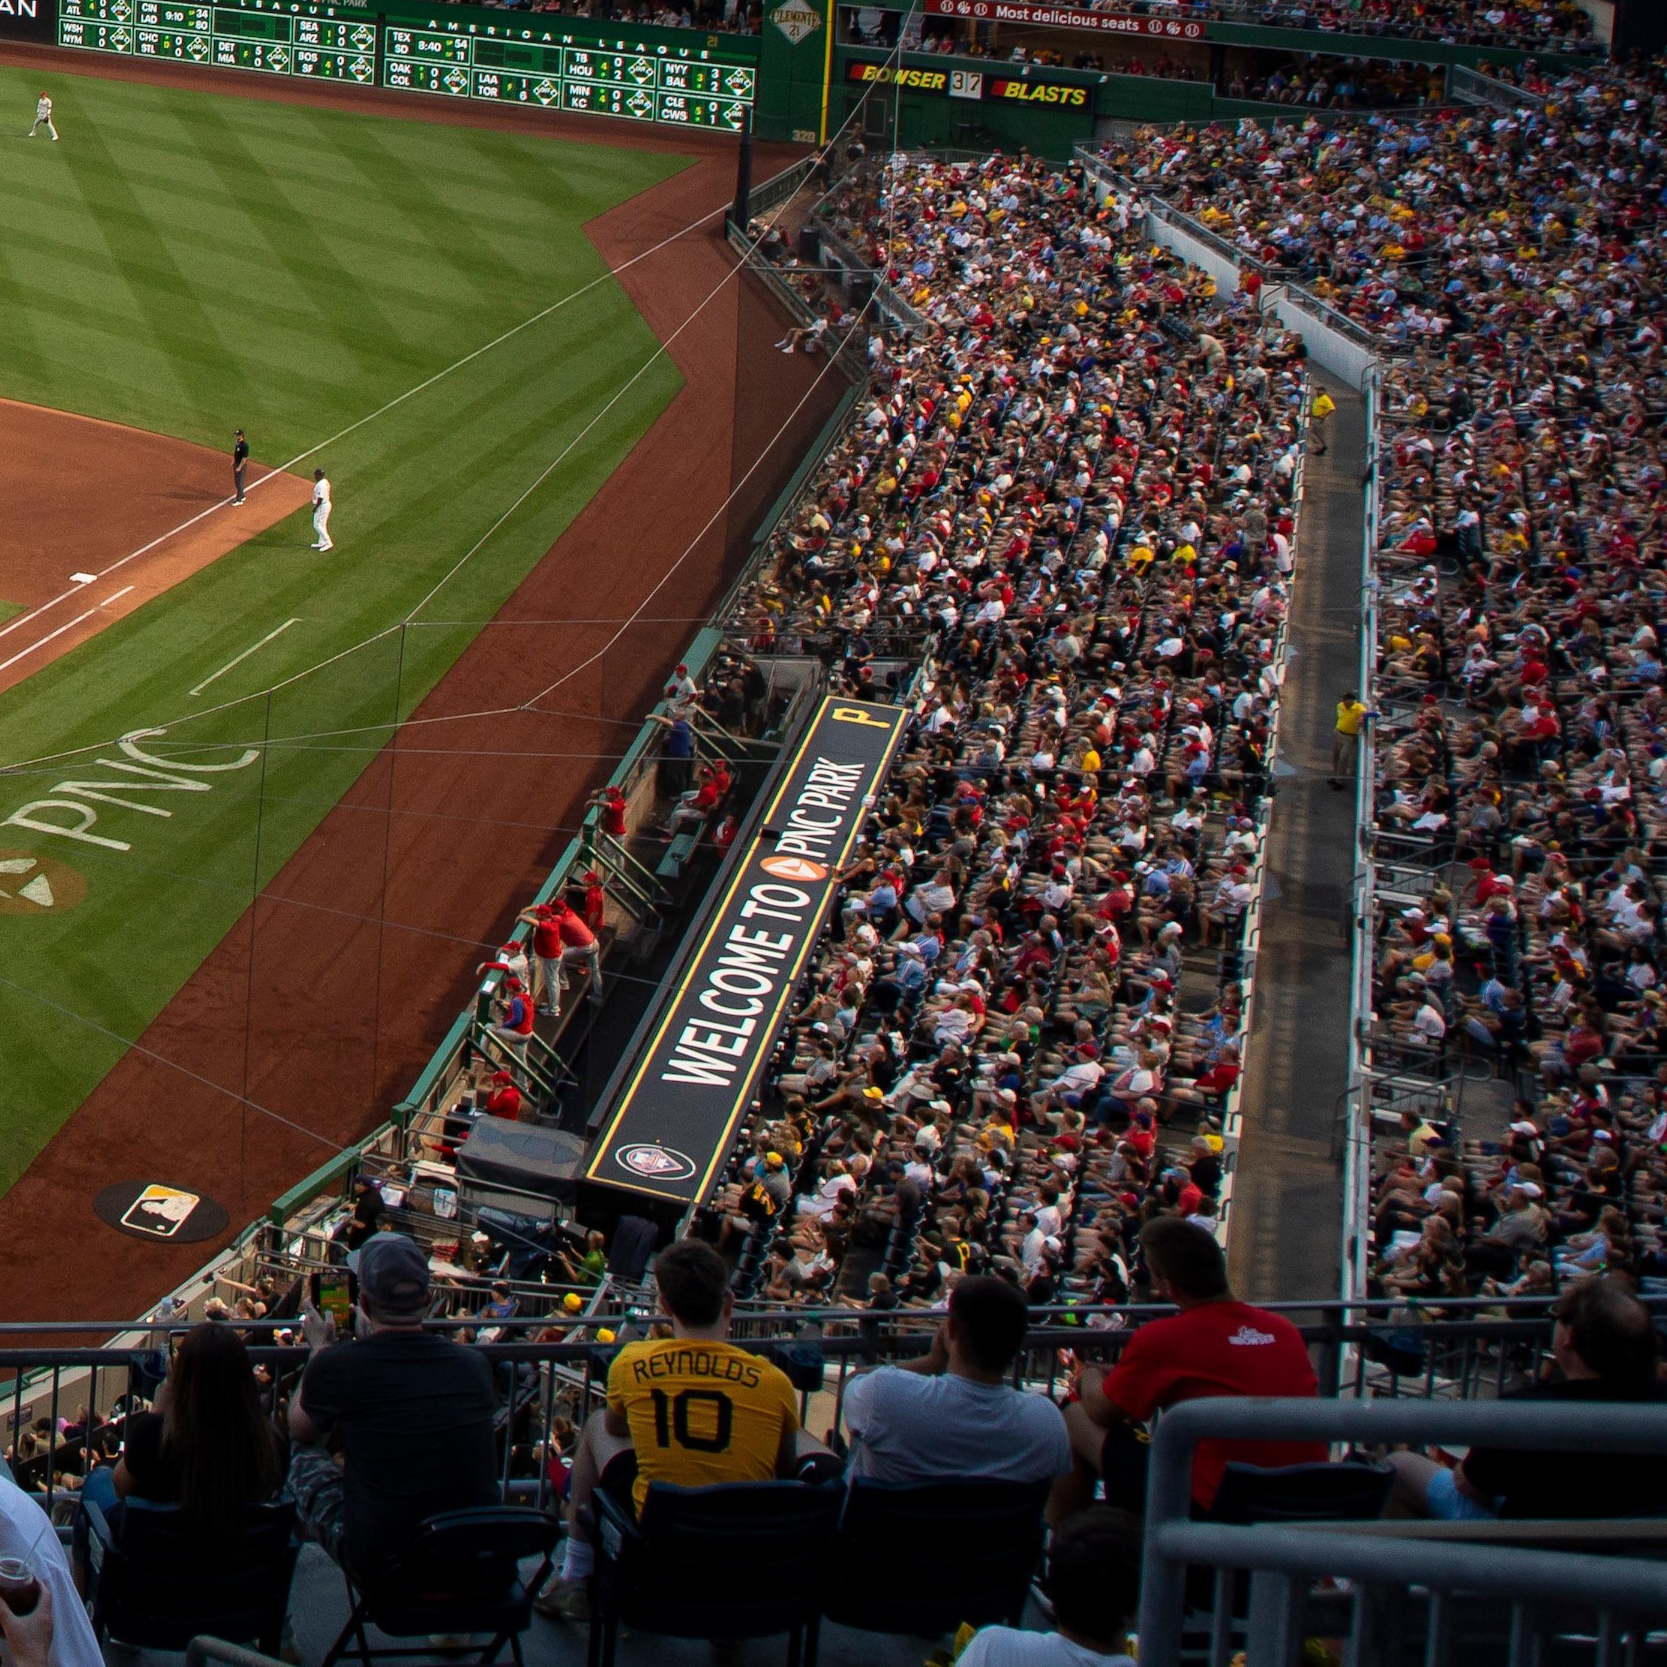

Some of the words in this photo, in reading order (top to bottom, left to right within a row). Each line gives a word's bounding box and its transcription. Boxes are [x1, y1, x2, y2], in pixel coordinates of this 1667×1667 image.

[165, 11, 184, 22] 9:10
[770, 6, 822, 28] CLEMENTE
[996, 5, 1029, 22] Most
[1032, 8, 1097, 28] delicious
[1101, 17, 1140, 32] seats
[300, 21, 319, 32] SEA
[299, 33, 318, 44] ARZ
[393, 32, 411, 42] TEX
[428, 19, 572, 44] AMERICAN
[598, 37, 710, 60] LEAGUE
[219, 42, 235, 52] DET
[394, 44, 409, 54] SD
[418, 40, 442, 53] 8:40
[218, 53, 235, 64] MIA
[298, 52, 318, 63] BOS
[575, 52, 588, 63] TB
[302, 64, 313, 74] SF
[390, 63, 411, 74] OAK
[569, 64, 593, 76] HOU
[666, 63, 688, 75] NYY
[390, 75, 410, 86] COL
[478, 73, 498, 84] LAA
[666, 76, 686, 88] BAL
[478, 85, 498, 97] TOR
[570, 85, 590, 97] MIN
[862, 65, 946, 91] BOWSER
[1003, 81, 1086, 106] BLASTS
[571, 97, 588, 108] KC
[665, 96, 685, 107] CLE
[661, 109, 688, 121] CWS
[0, 727, 260, 852] PNC
[797, 756, 865, 812] PARK
[774, 807, 843, 859] PNC
[740, 883, 811, 922] TO
[661, 925, 794, 1086] WELCOME
[633, 1351, 763, 1389] REYNOLDS
[650, 1388, 733, 1454] 10
